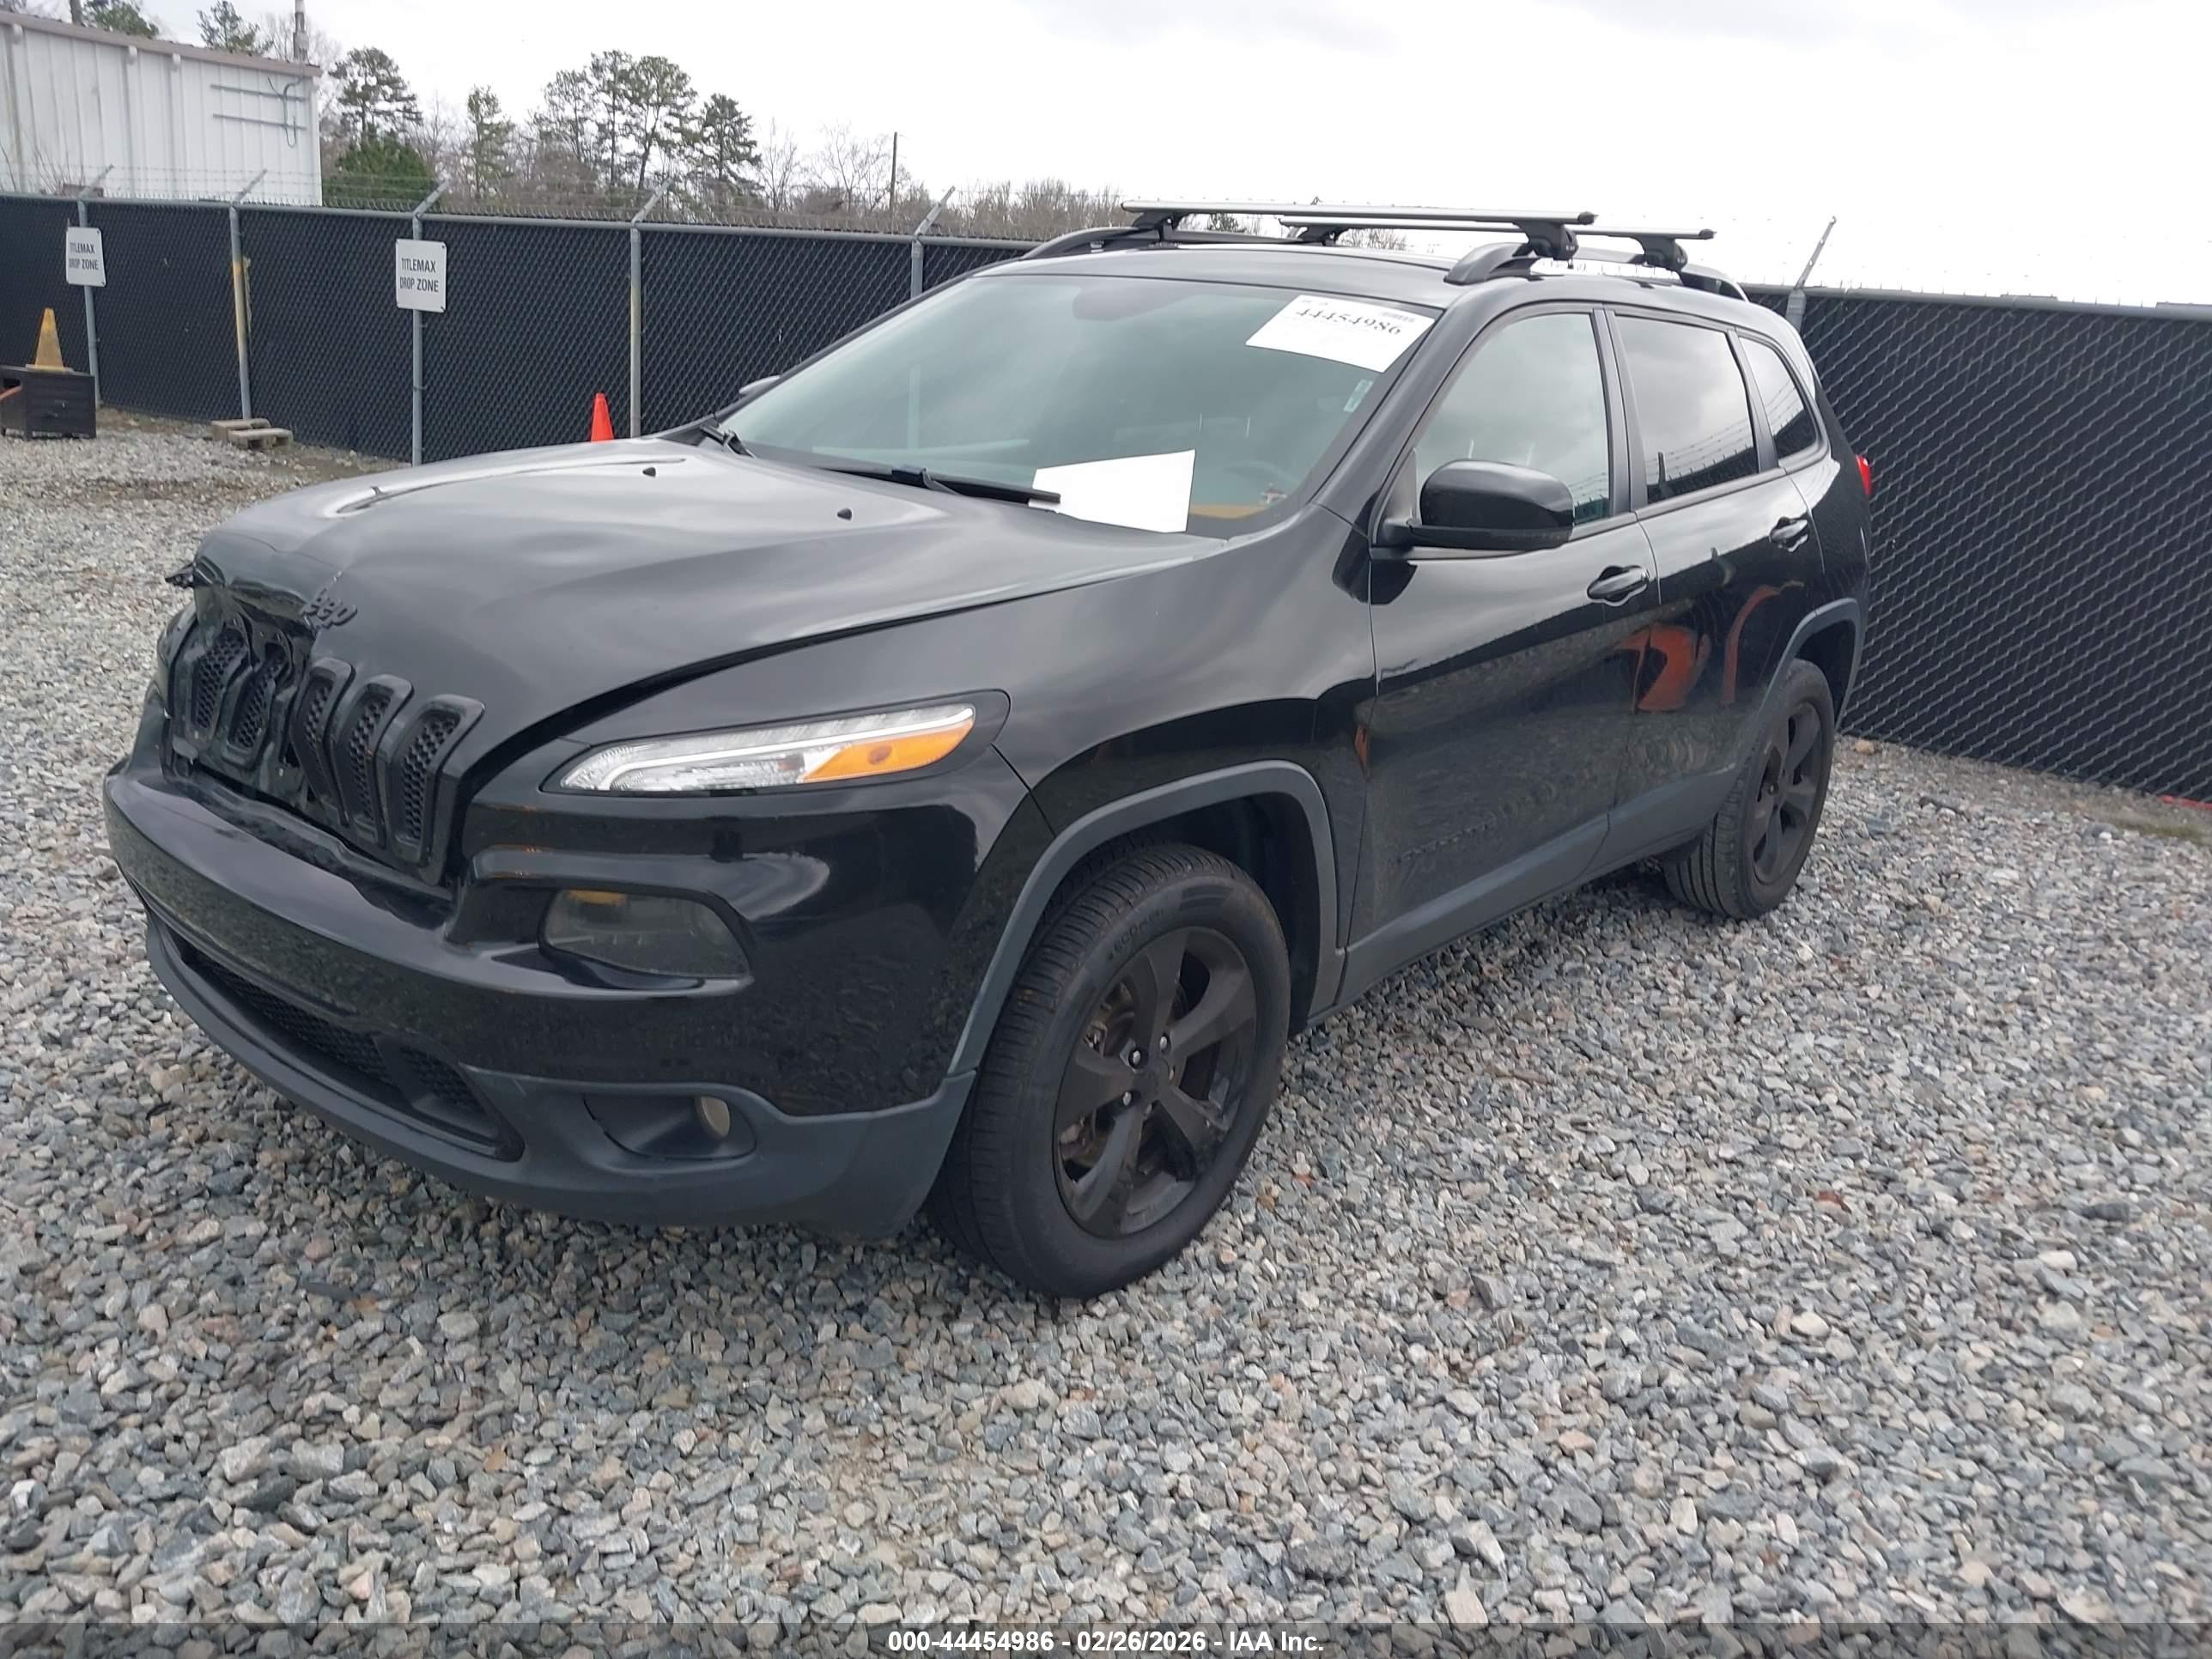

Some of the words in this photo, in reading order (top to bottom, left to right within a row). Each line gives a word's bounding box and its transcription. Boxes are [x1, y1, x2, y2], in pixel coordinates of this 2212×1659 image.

[82, 258, 99, 270] ZONE
[401, 258, 436, 273] TITLEMAX
[399, 276, 415, 289] DROP
[416, 277, 439, 293] ZONE
[1296, 308, 1401, 335] 44454986
